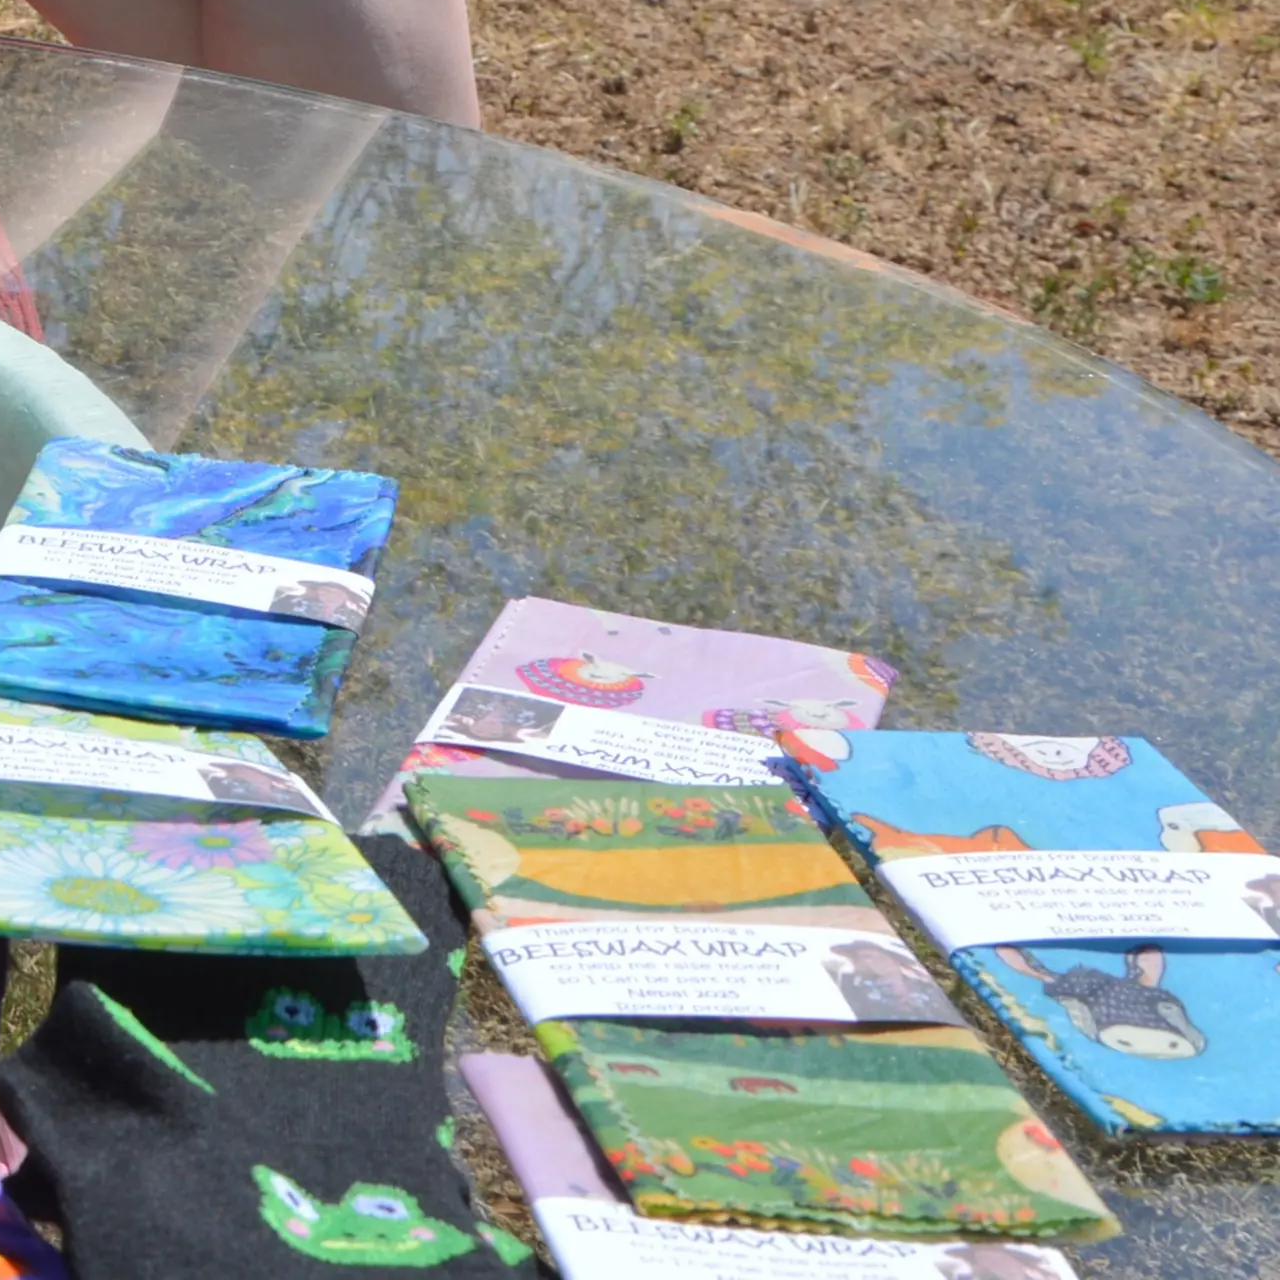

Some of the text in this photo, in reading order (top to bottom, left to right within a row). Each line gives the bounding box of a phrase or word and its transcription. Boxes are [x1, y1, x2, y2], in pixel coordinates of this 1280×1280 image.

[546, 742, 652, 770] WRAP
[918, 866, 1213, 889] BEESWAX WRAP
[493, 939, 808, 967] BEESWAX WRAP
[627, 987, 740, 1000] Nepal 2025
